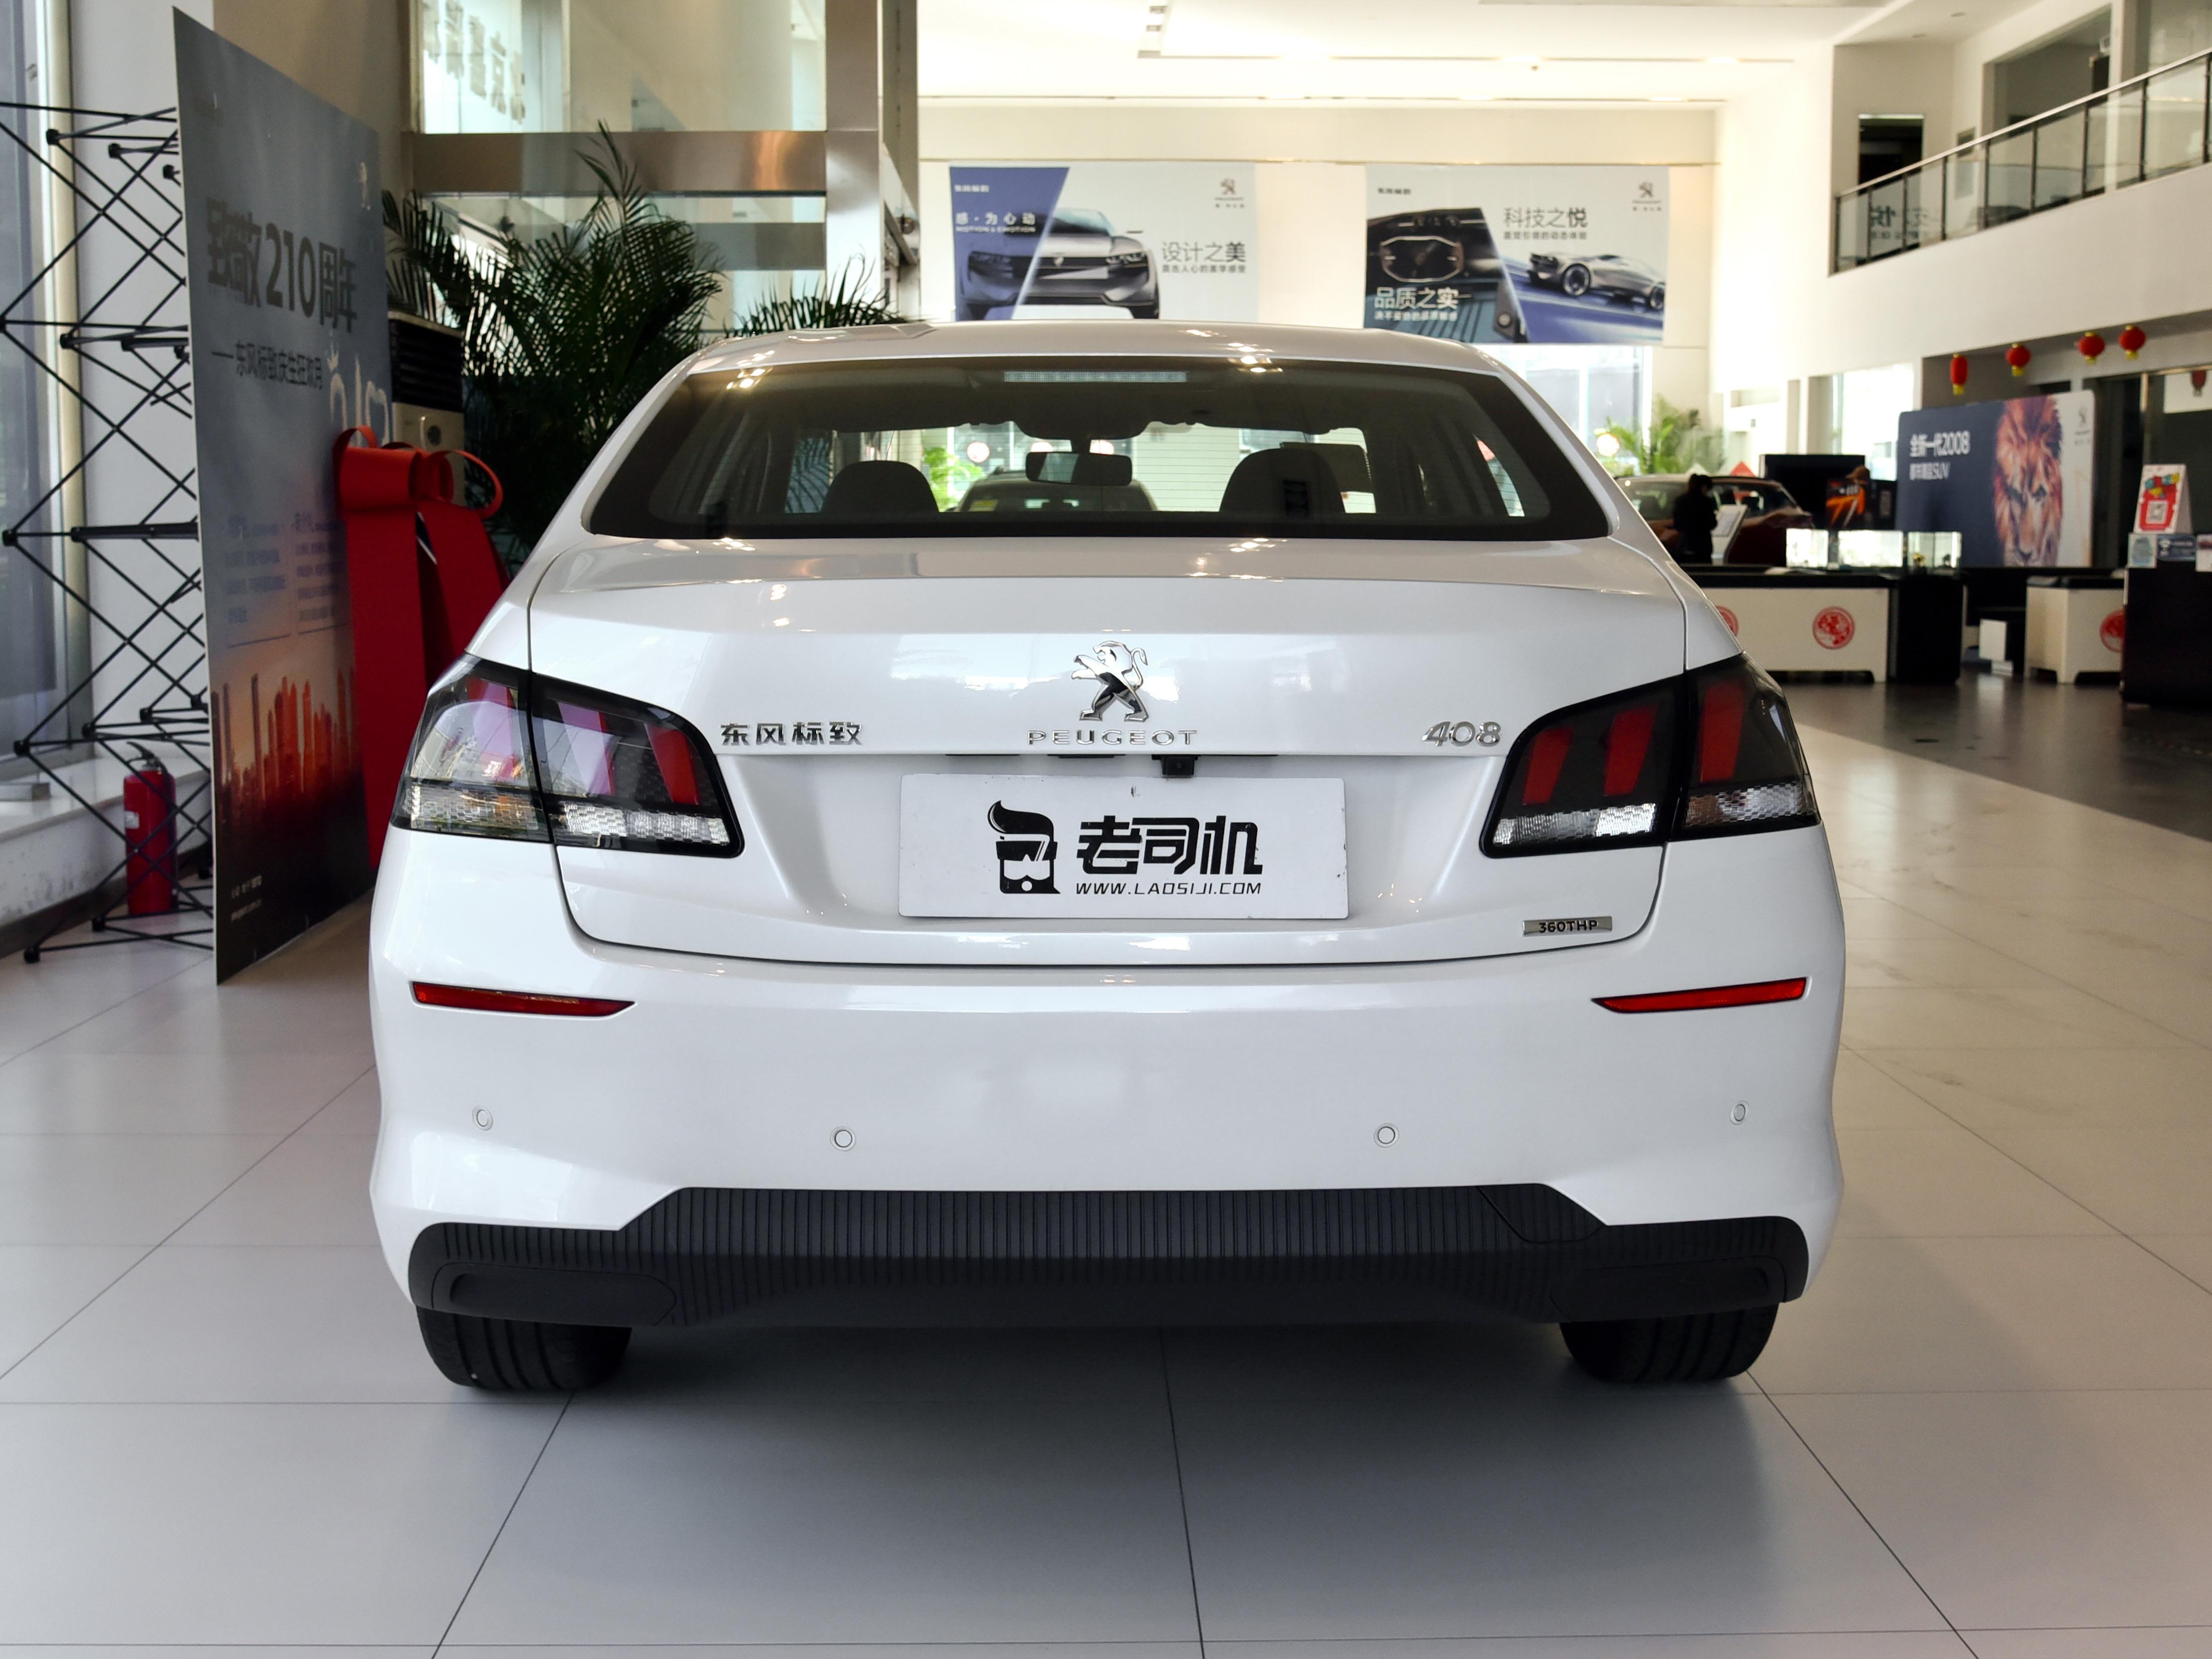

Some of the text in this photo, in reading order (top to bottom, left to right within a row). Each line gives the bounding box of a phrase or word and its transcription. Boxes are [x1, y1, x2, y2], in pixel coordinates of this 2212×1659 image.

[1503, 207, 1588, 228] 科技之悦
[1162, 241, 1246, 262] 设计之美
[1374, 287, 1458, 309] 品质之实
[1909, 430, 1970, 457] 全新一代2008
[720, 722, 862, 745] 东风标致
[1027, 729, 1197, 746] PEUGEOT
[1421, 721, 1501, 748] 408
[1076, 815, 1263, 875] 老司机
[1075, 882, 1262, 895] WWW.LAOSIJI.COM
[1539, 919, 1598, 933] 360THP
